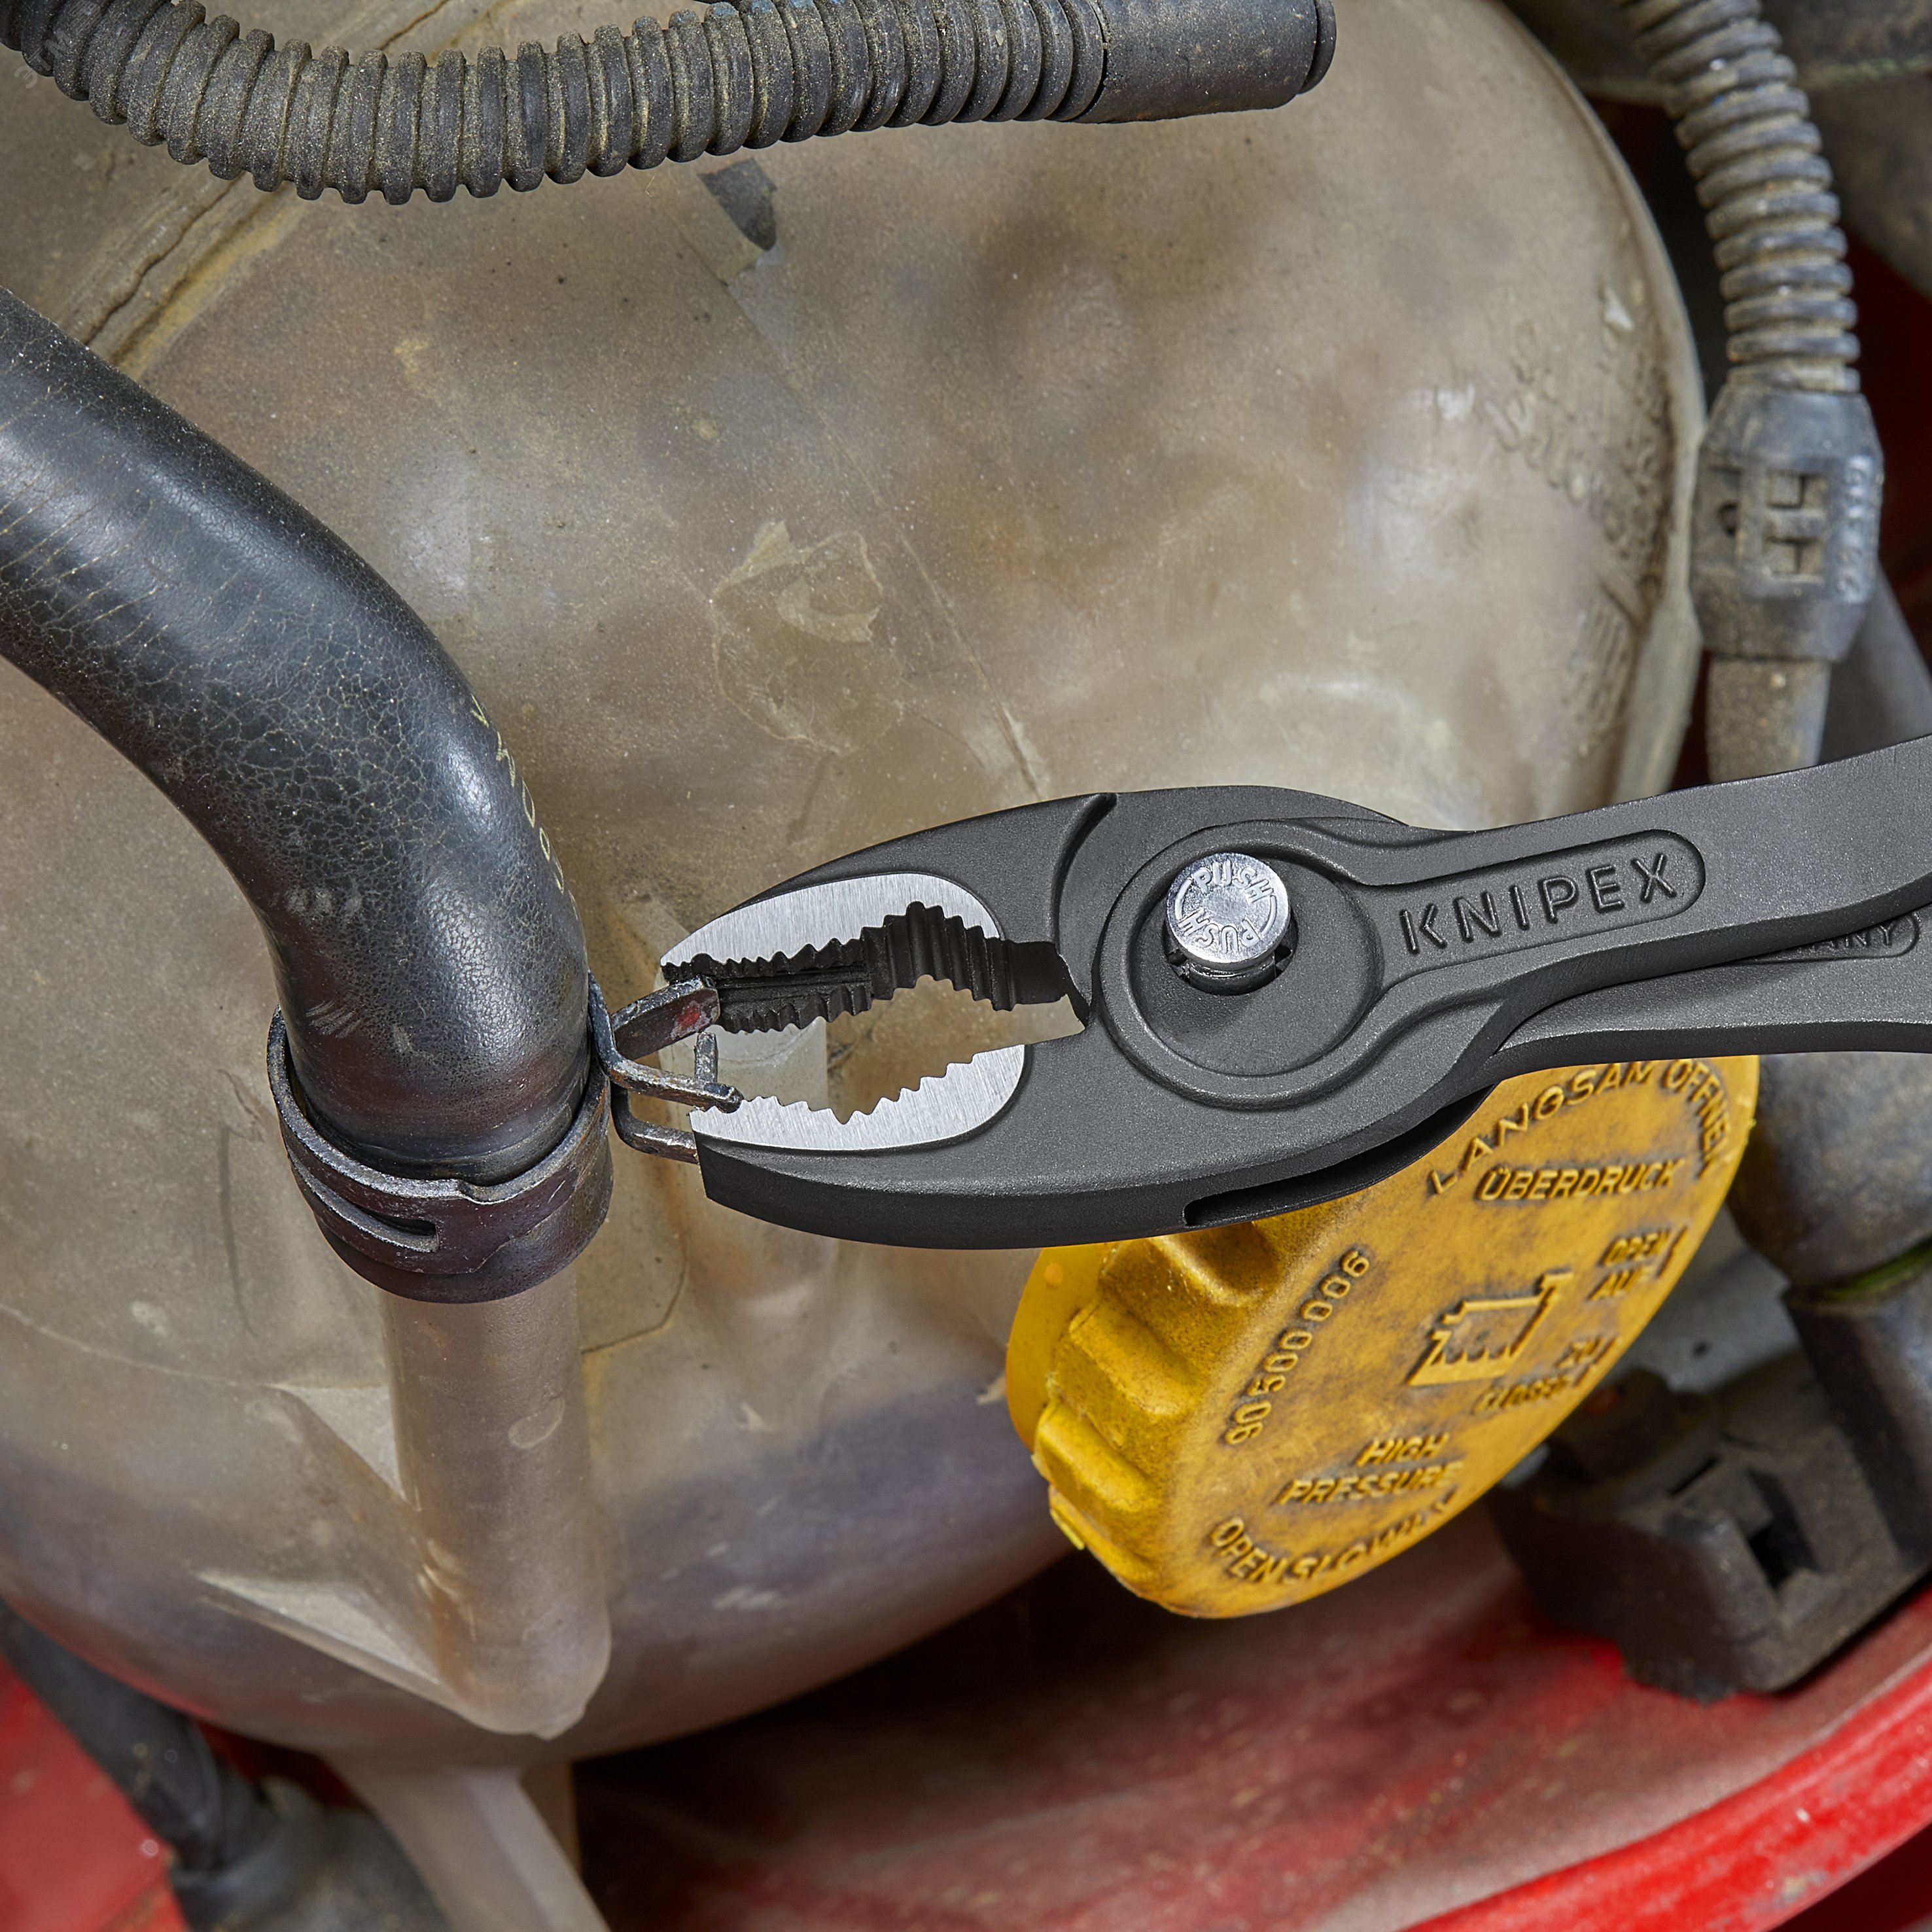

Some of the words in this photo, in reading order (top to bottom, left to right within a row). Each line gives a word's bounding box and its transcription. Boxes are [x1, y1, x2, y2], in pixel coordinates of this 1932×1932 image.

[1191, 858, 1276, 905] PUSH
[1399, 852, 1677, 955] KNIPEX
[1178, 905, 1263, 954] PUSH
[1427, 1059, 1657, 1196] LANGSAM
[1475, 1158, 1686, 1203] ÜBERDRUCK
[1356, 1431, 1450, 1467] HIGH
[1273, 1460, 1465, 1507] PRESSURE
[1210, 1516, 1290, 1584] OPEN
